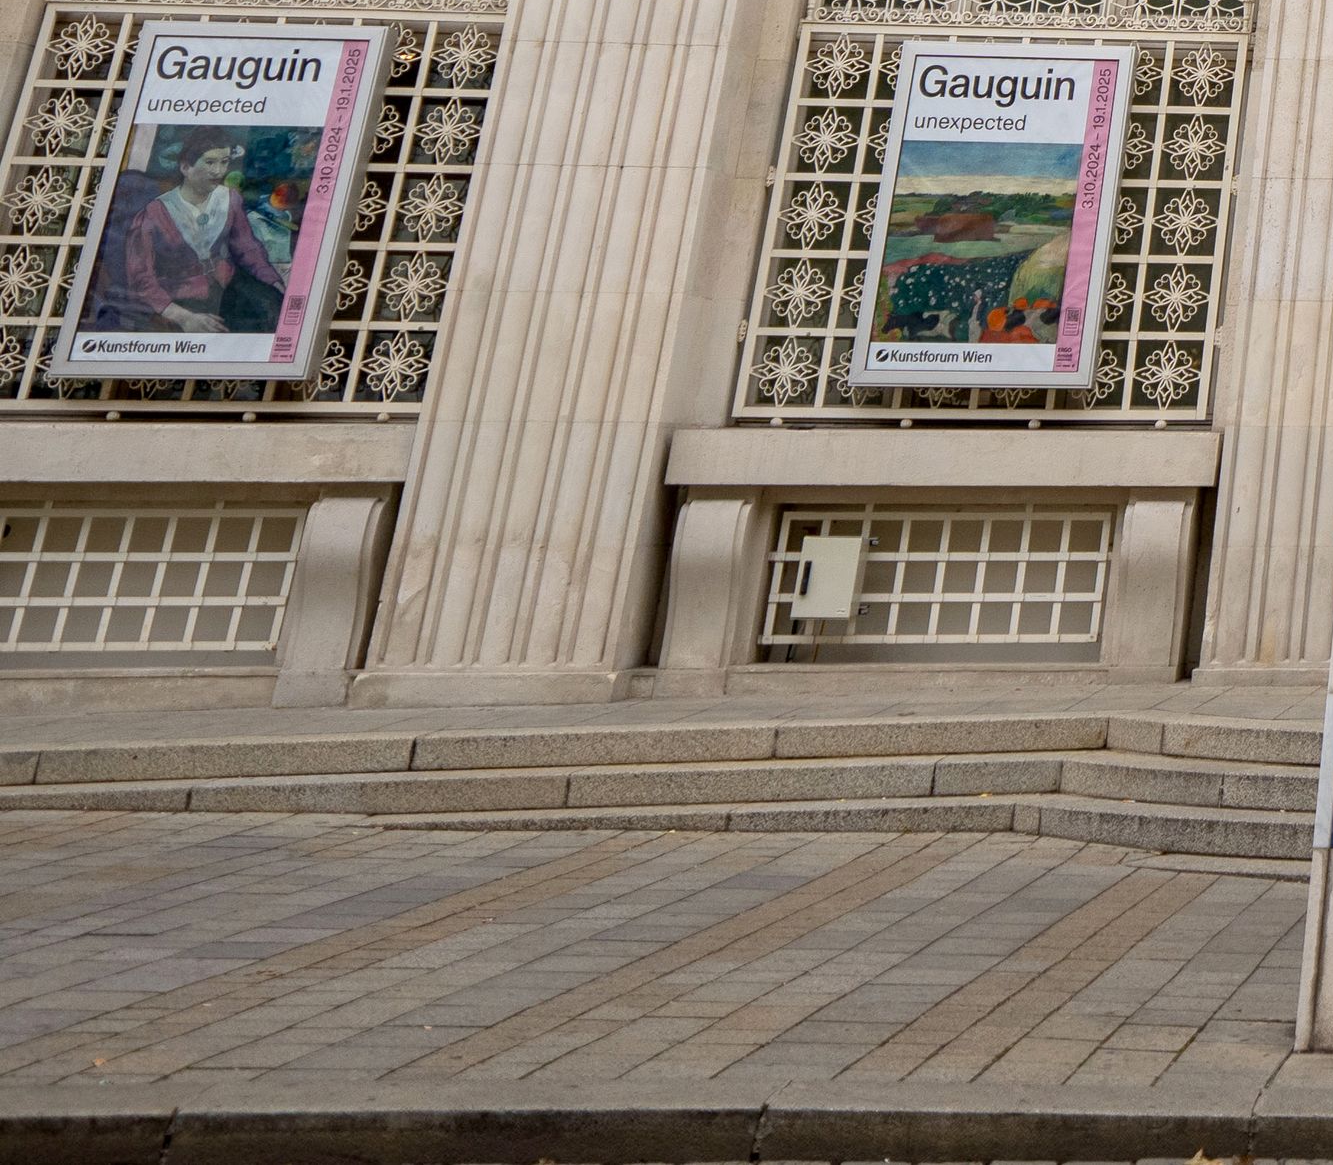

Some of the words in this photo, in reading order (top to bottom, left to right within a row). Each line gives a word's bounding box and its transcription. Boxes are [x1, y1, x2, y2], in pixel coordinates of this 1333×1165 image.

[157, 46, 321, 89] Gauguin
[920, 65, 1075, 107] Gauguin
[148, 97, 267, 116] unexpected
[316, 127, 342, 193] 3.10.2024
[336, 49, 361, 111] 19.1.2025
[915, 115, 1026, 133] unexpected
[1082, 143, 1101, 208] 3.10.2024
[1093, 69, 1111, 129] 19.1.2025
[98, 340, 170, 353] Kunstforum
[175, 341, 206, 353] Wien
[890, 350, 958, 362] Kunstforum
[963, 351, 992, 363] Wien
